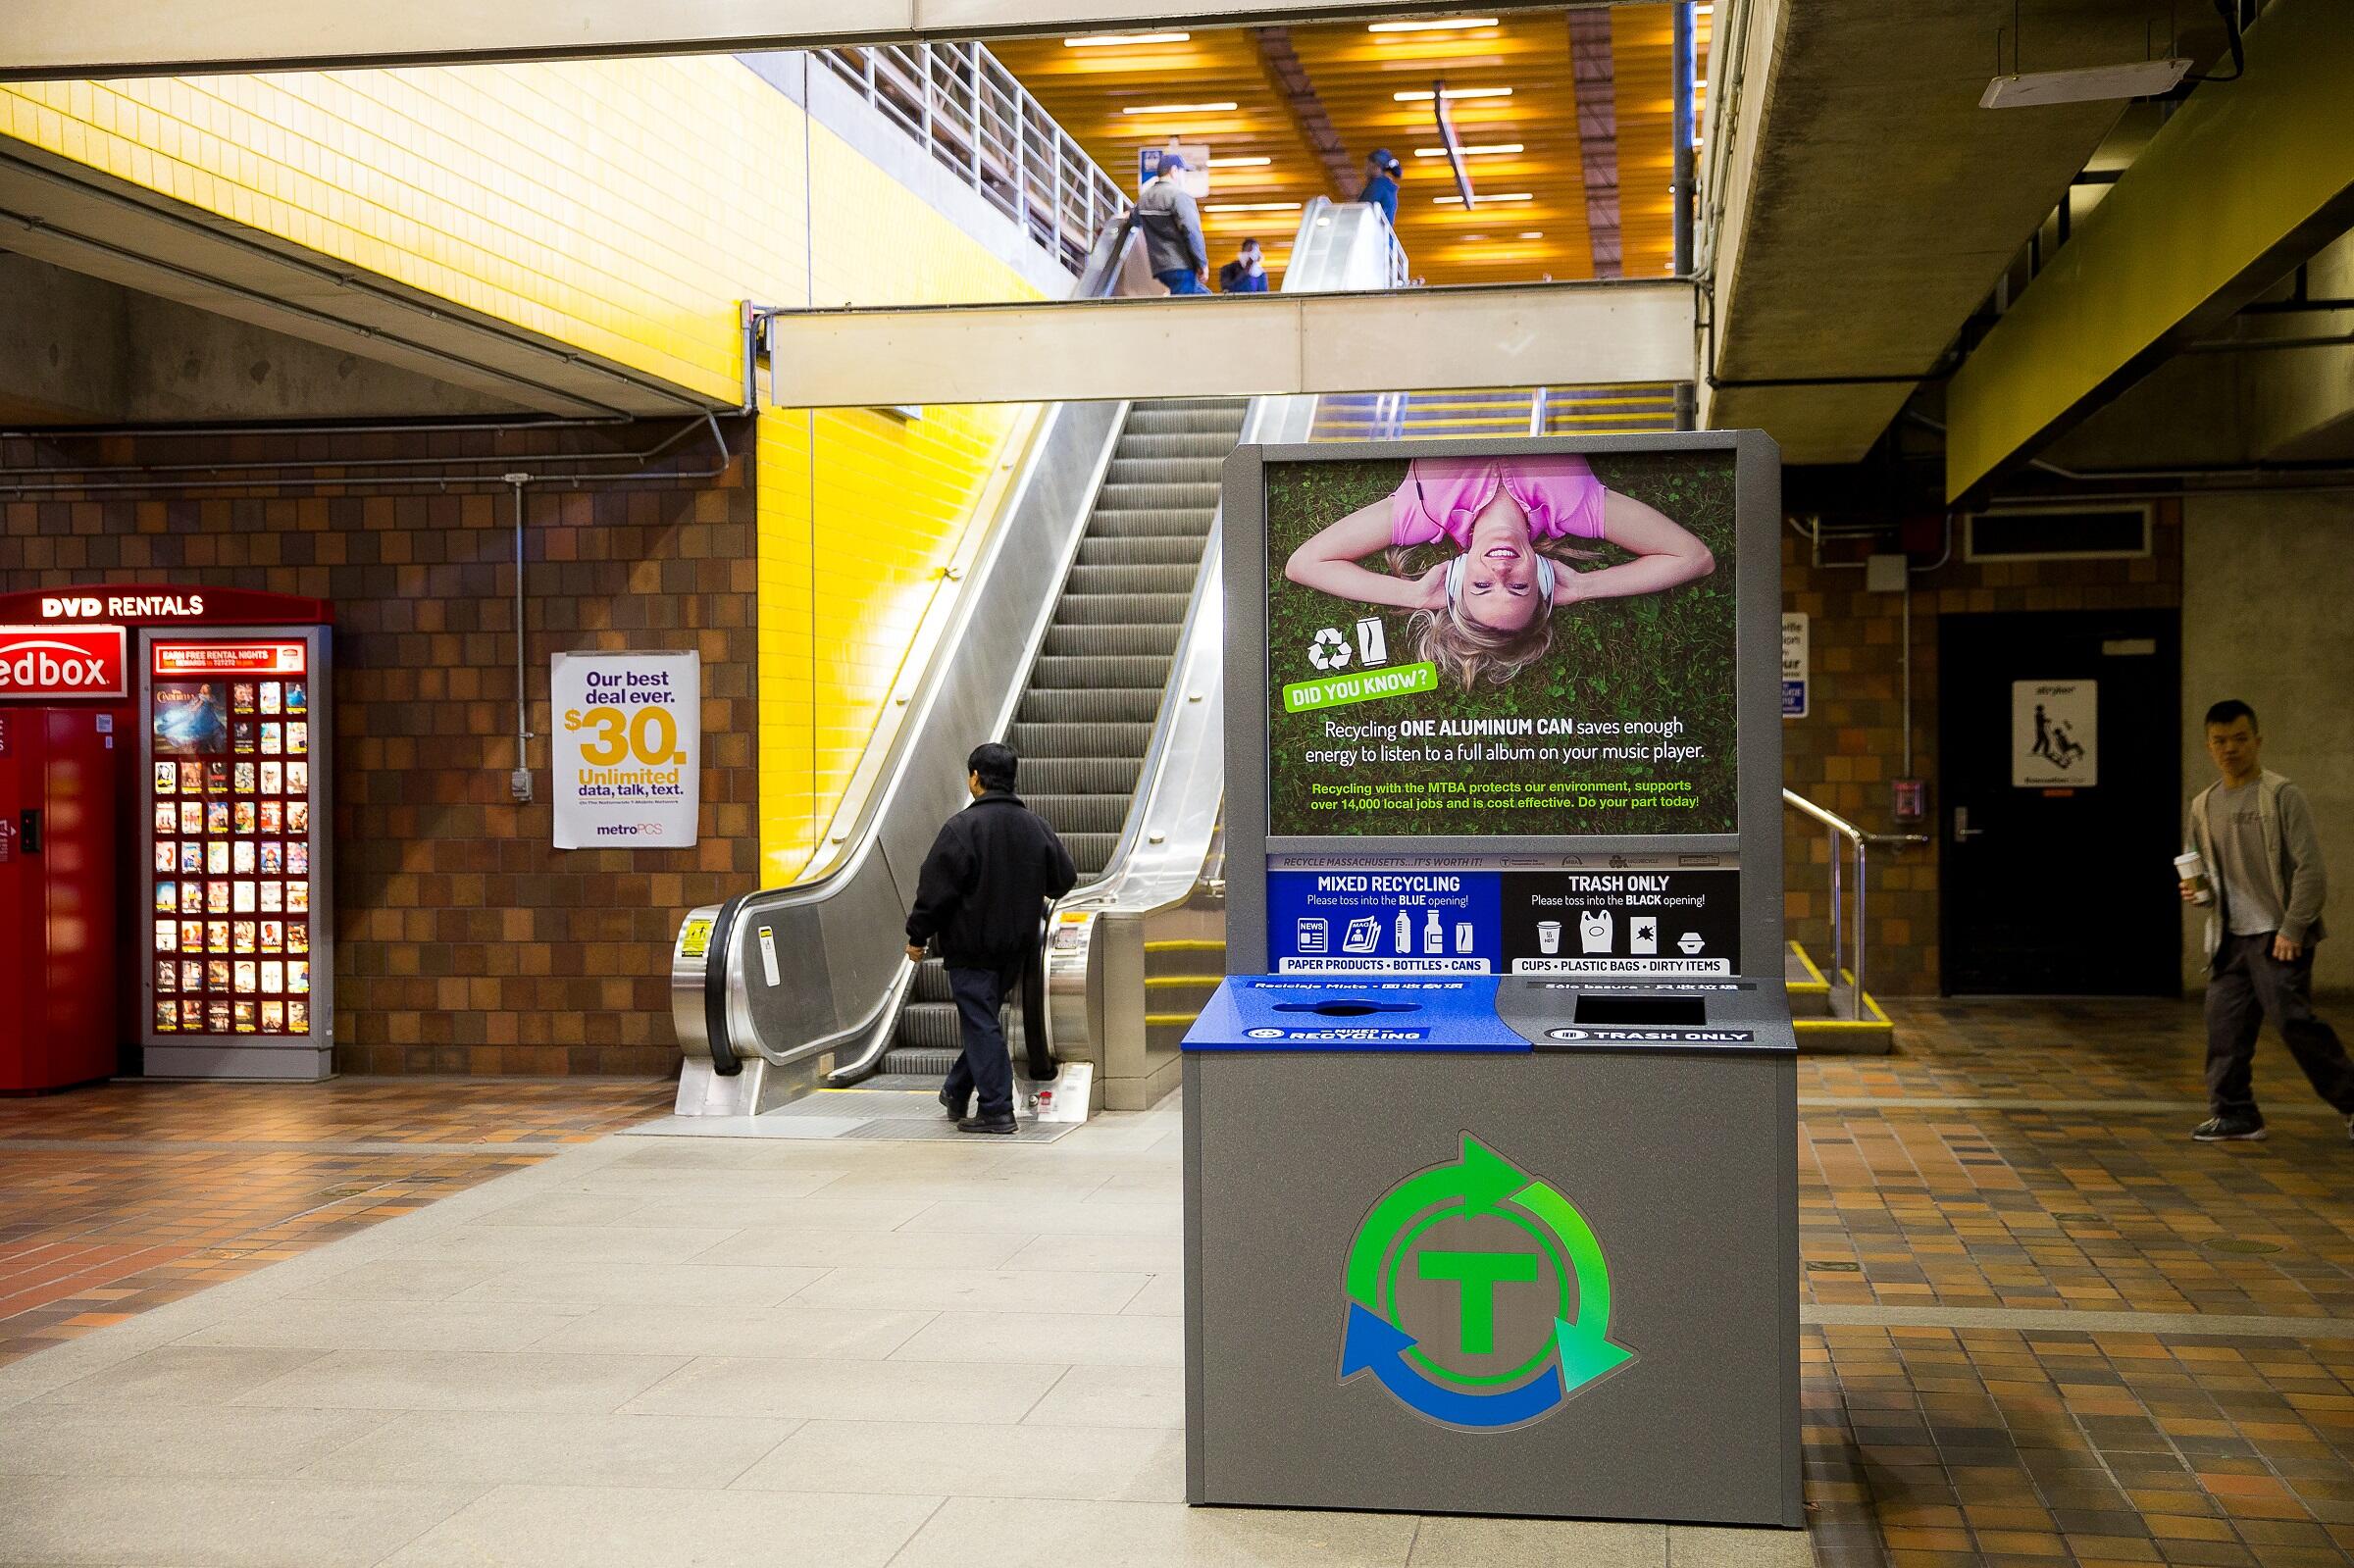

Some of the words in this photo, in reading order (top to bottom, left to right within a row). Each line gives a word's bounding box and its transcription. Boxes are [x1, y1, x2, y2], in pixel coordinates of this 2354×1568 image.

[42, 597, 103, 618] DVD
[108, 595, 204, 616] RENTALS
[162, 650, 184, 660] EARN
[185, 650, 206, 659] FREE
[206, 650, 237, 659] RENTAL
[238, 649, 269, 659] NIGHTS
[587, 672, 622, 687] Our
[627, 671, 669, 686] best
[1292, 686, 1322, 707] DID
[1324, 681, 1360, 701] YOU
[1363, 669, 1428, 695] KNOW?
[586, 688, 626, 704] deal
[630, 690, 676, 704] ever.
[1325, 721, 1397, 741] Recycling
[1401, 720, 1436, 736] ONE
[1439, 719, 1532, 736] ALUMINUM
[1537, 718, 1573, 735] CAN
[1576, 721, 1620, 734] saves
[1624, 716, 1683, 738] enough
[1305, 748, 1357, 767] energy
[1361, 745, 1377, 762] to
[1380, 744, 1420, 762] listen
[1425, 744, 1440, 762] to
[1444, 748, 1454, 761] a
[1458, 743, 1483, 761] full
[1486, 742, 1535, 761] album
[1539, 746, 1559, 760] on
[1562, 745, 1599, 765] your
[1603, 742, 1650, 760] music
[1654, 741, 1705, 763] player.
[579, 768, 679, 785] Unlimited
[579, 784, 616, 799] data,
[617, 784, 649, 798] talk,
[651, 784, 684, 796] text.
[1311, 783, 1372, 796] Recycling
[1375, 783, 1402, 793] with
[1405, 783, 1424, 793] the
[1428, 782, 1465, 793] MTBA
[1469, 782, 1521, 795] protects
[1524, 783, 1546, 792] our
[1549, 781, 1631, 793] environment,
[1634, 781, 1692, 793] supports
[1310, 800, 1338, 810] over
[1341, 798, 1380, 812] 14,000
[1383, 798, 1413, 810] local
[1416, 797, 1444, 811] jobs
[1446, 797, 1469, 809] and
[1473, 797, 1484, 808] is
[1487, 797, 1514, 809] cost
[1517, 796, 1574, 808] effective.
[1578, 796, 1596, 808] Do
[1599, 797, 1628, 810] your
[1631, 796, 1658, 809] part
[1661, 795, 1699, 810] today!
[597, 823, 663, 835] metroPCS
[1284, 857, 1325, 867] RECYCLE
[1433, 858, 1469, 867] WORTH
[1470, 858, 1483, 867] IT!
[1318, 876, 1367, 891] MIXED
[1371, 876, 1460, 891] RECYCLING
[1568, 876, 1623, 891] TRASH
[1627, 876, 1669, 891] ONLY
[1307, 895, 1338, 906] Please
[1340, 896, 1358, 905] toss
[1360, 895, 1379, 905] into
[1381, 895, 1397, 905] the
[1399, 895, 1426, 905] BLUE
[1428, 894, 1469, 908] opening!
[1531, 894, 1562, 906] Please
[1565, 896, 1585, 906] toss
[1587, 895, 1605, 905] into
[1608, 895, 1623, 905] the
[1625, 894, 1662, 905] BLACK
[1663, 894, 1706, 908] opening!
[1288, 960, 1323, 970] PAPER
[1326, 960, 1384, 970] PRODUCTS
[1393, 960, 1442, 970] BOTTLES
[1452, 960, 1481, 970] CANS
[1521, 960, 1552, 971] CUPS
[1561, 960, 1608, 971] PLASTIC
[1610, 960, 1640, 971] BAGS
[1650, 960, 1682, 971] DIRTY
[1685, 960, 1720, 971] ITEMS
[1594, 1032, 1680, 1040] TRASH
[1686, 1032, 1749, 1040] ONLY
[1418, 1250, 1539, 1354] T
